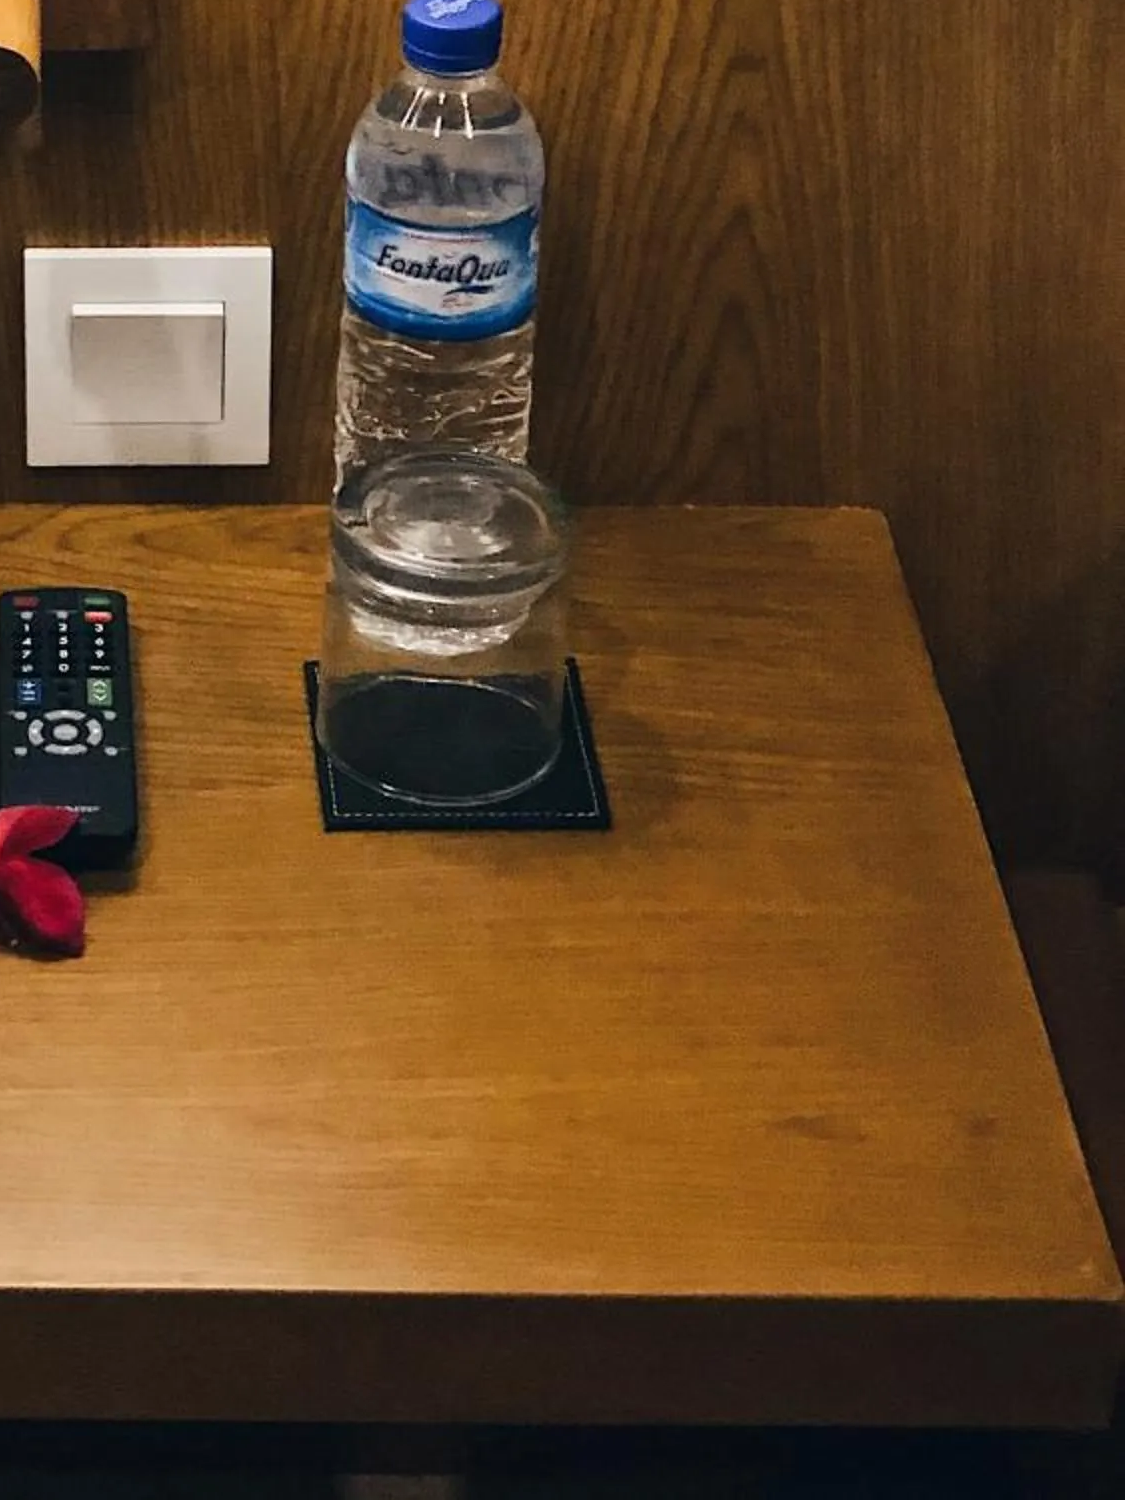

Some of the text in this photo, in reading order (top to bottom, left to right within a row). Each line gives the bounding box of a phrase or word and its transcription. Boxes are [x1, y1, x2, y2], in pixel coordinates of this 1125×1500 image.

[376, 243, 511, 284] FontaQua
[58, 623, 68, 632] 2
[94, 623, 104, 633] 3
[22, 649, 32, 659] 7
[94, 649, 104, 659] 9
